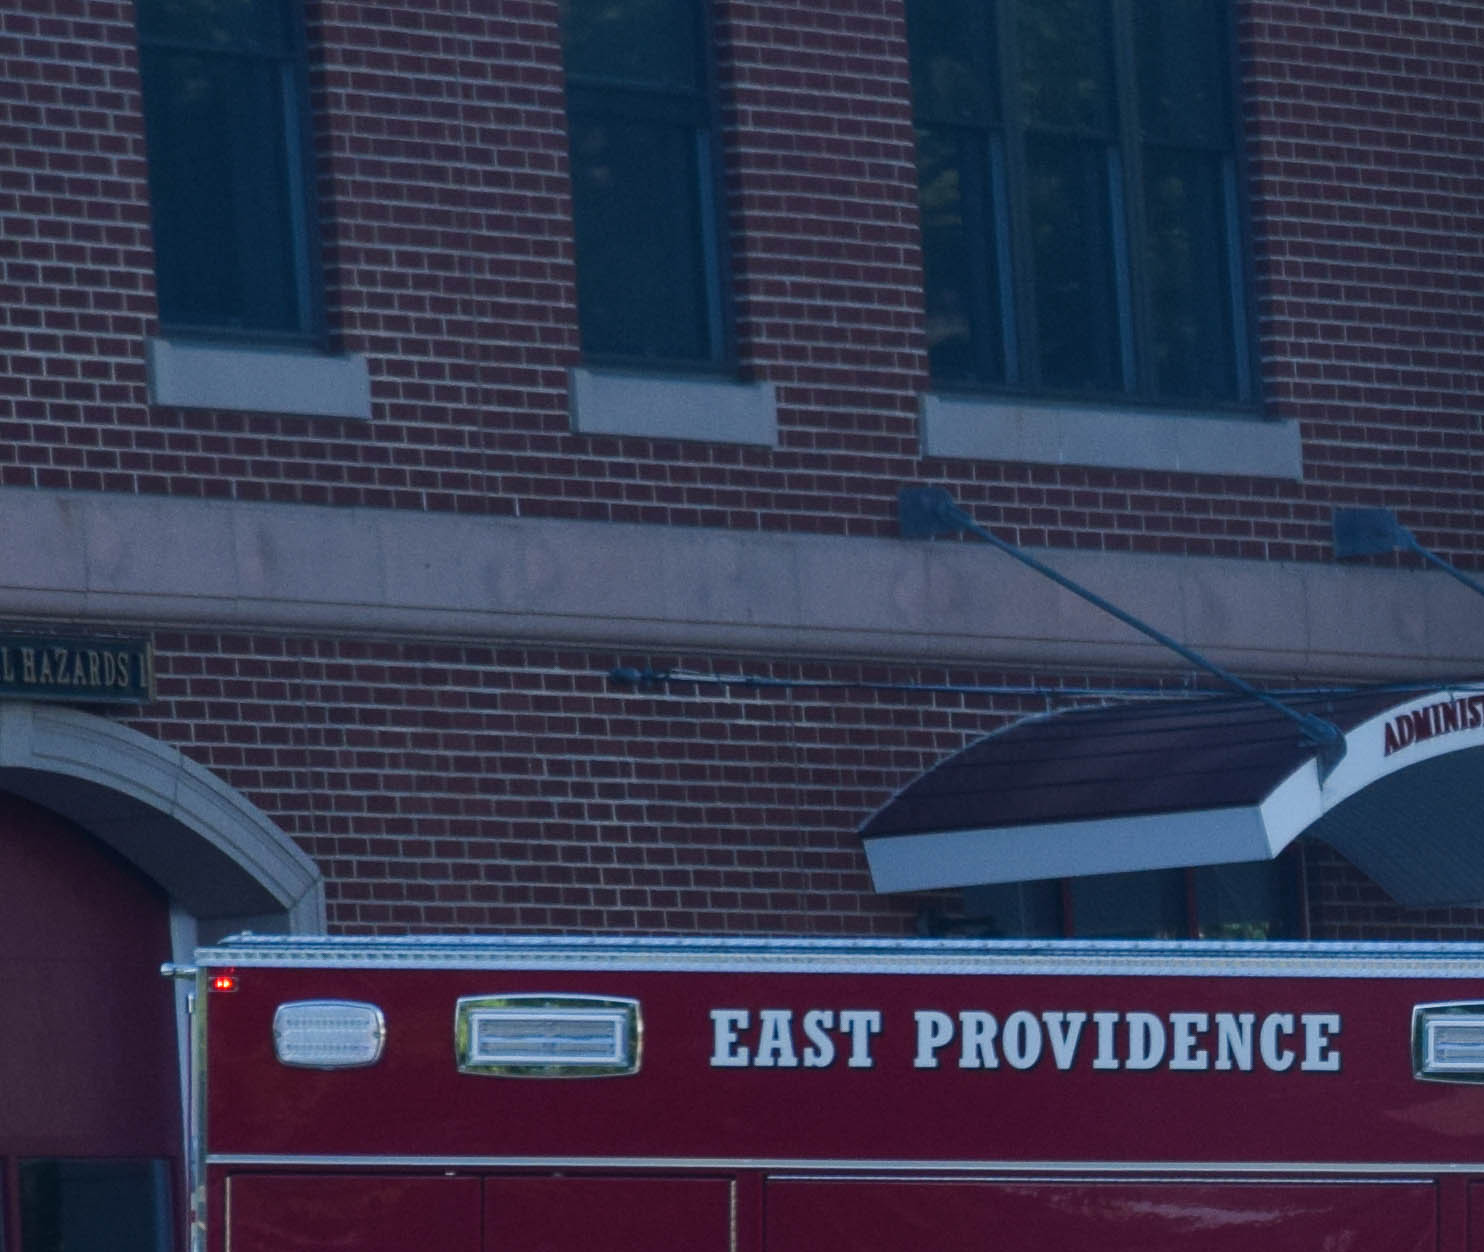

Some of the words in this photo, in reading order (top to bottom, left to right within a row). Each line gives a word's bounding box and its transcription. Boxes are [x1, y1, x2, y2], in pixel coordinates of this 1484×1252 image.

[22, 647, 130, 687] HAZARDS
[710, 1010, 881, 1068] EAST
[913, 1011, 1341, 1071] PROVIDENCE
